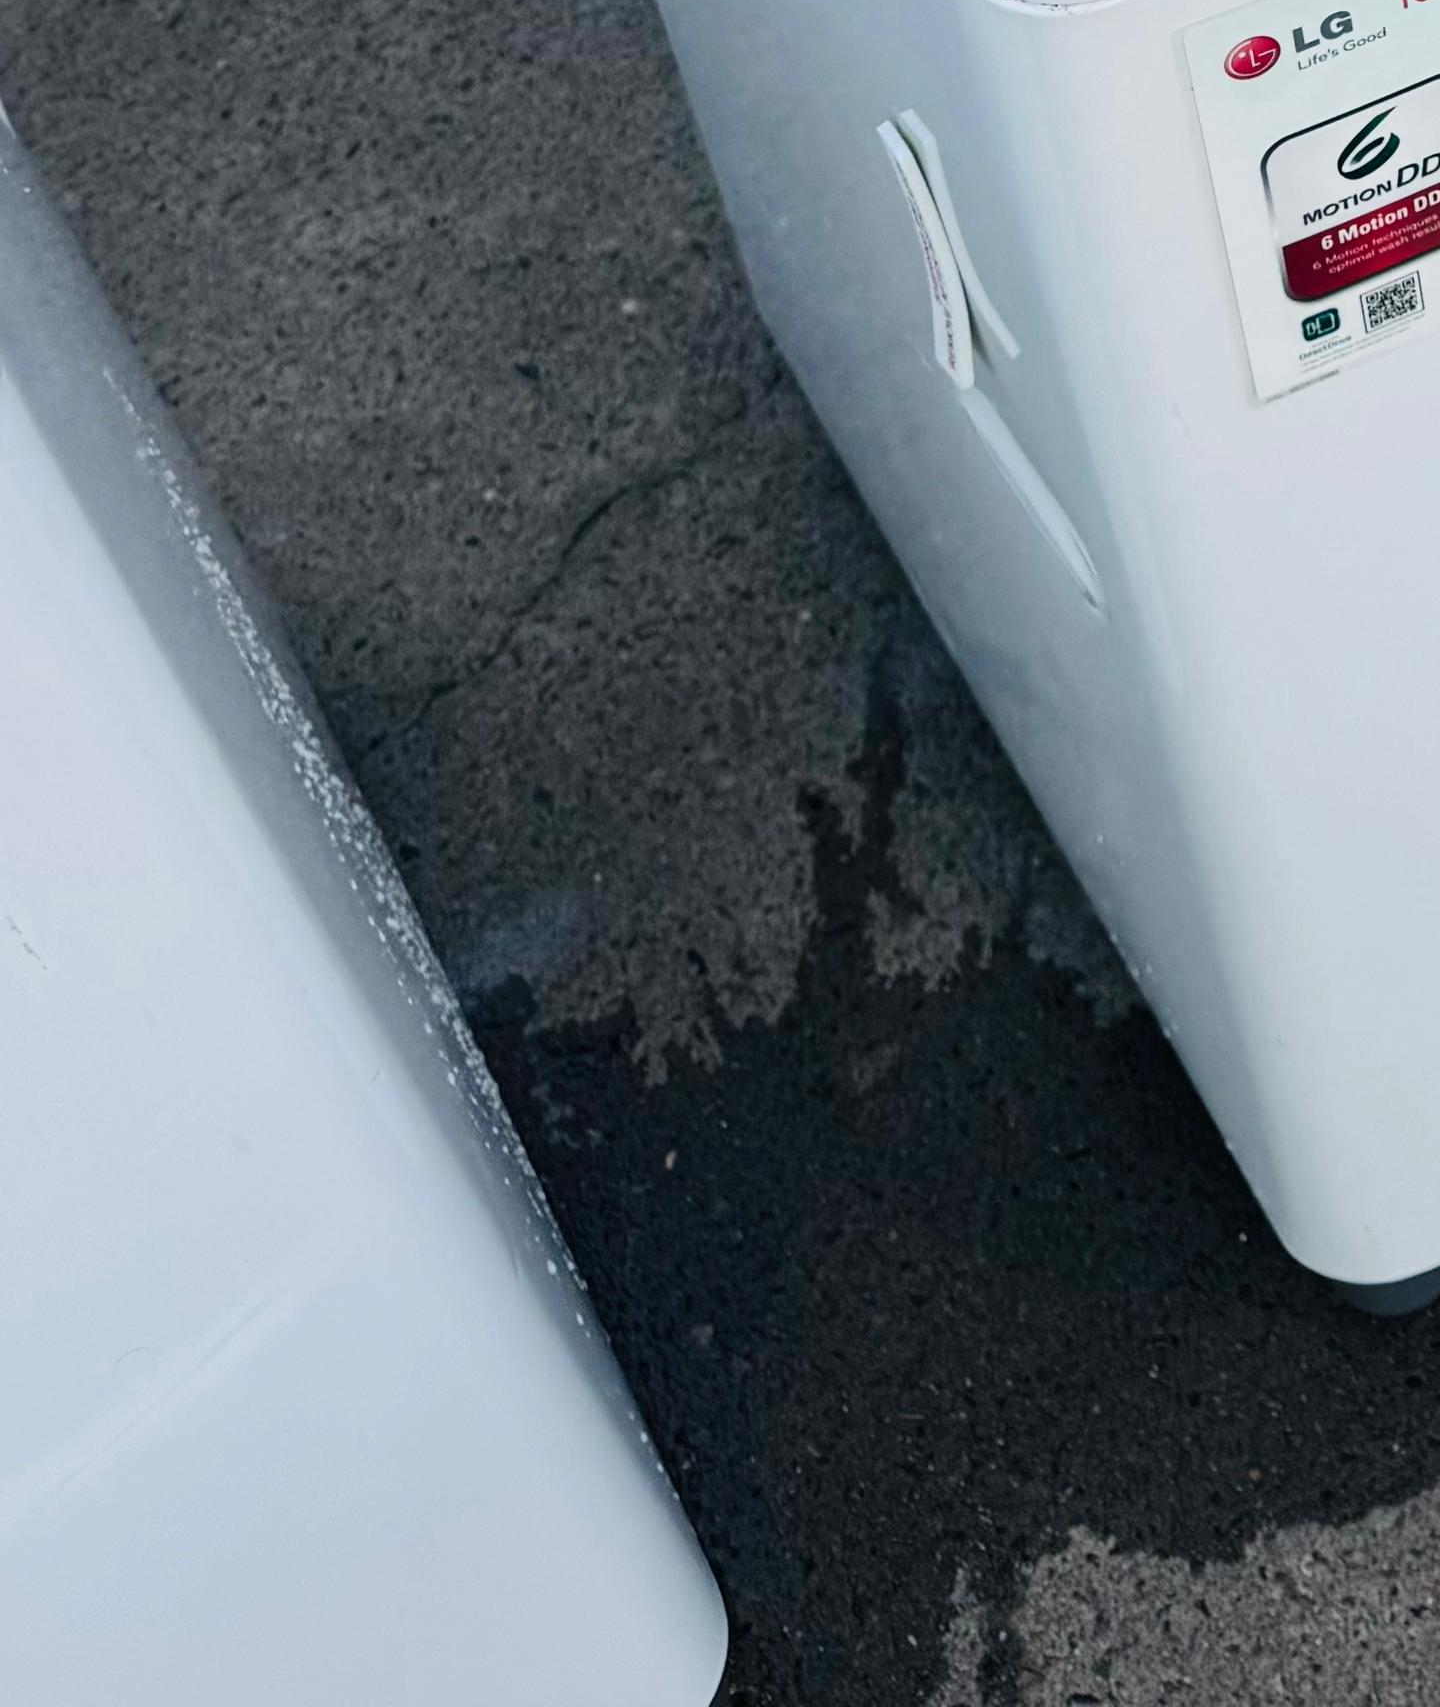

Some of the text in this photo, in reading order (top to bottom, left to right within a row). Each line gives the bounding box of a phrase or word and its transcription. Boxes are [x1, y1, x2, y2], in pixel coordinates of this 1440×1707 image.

[1292, 10, 1354, 54] LG
[1297, 26, 1388, 71] Life's Good
[1302, 180, 1394, 226] MOTION
[1312, 260, 1322, 271] 6
[1325, 243, 1370, 266] Motion
[1372, 213, 1439, 247] techniques
[1320, 235, 1335, 251] 6
[1337, 208, 1409, 245] Motion
[1328, 249, 1376, 275] optimal
[1378, 236, 1410, 256] wash
